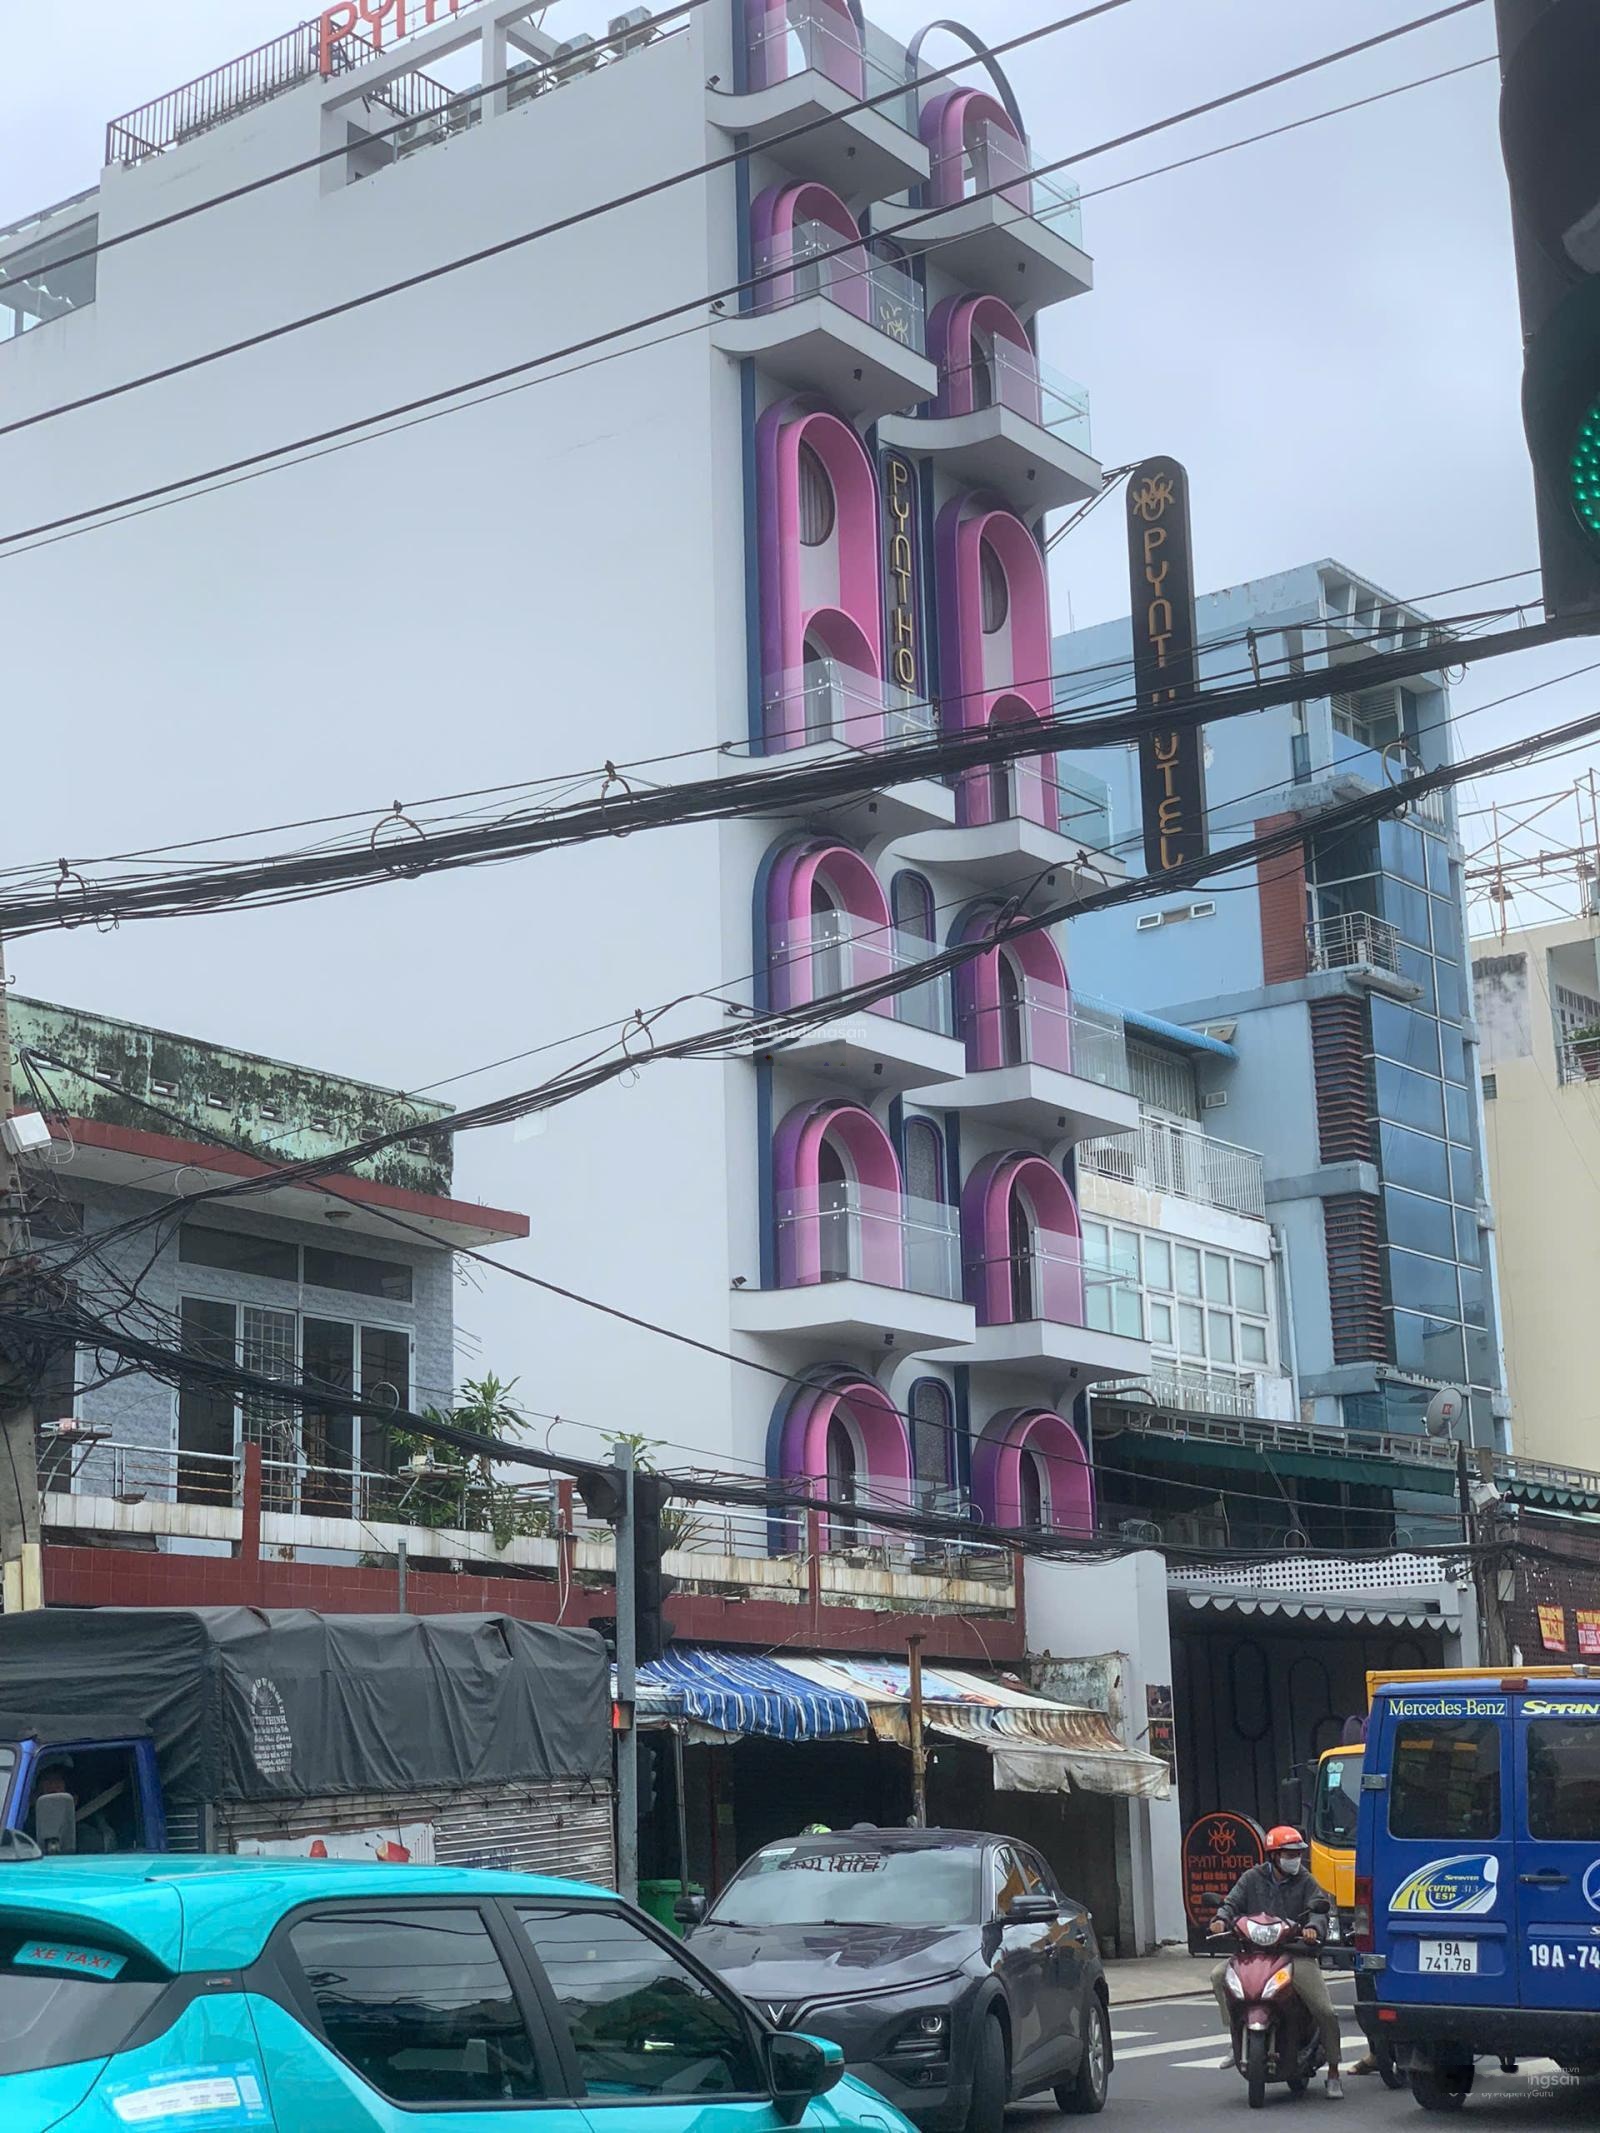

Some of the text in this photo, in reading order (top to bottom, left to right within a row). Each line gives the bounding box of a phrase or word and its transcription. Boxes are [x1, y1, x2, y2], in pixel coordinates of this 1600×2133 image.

[891, 461, 911, 604] PYNT
[1143, 527, 1184, 870] PYNT OTEL
[1389, 1699, 1600, 1715] Mercedes-Benz SPRIN
[31, 1947, 111, 1969] XE TAXI
[1437, 1943, 1460, 1956] 19A
[1425, 1957, 1471, 1972] 741.78
